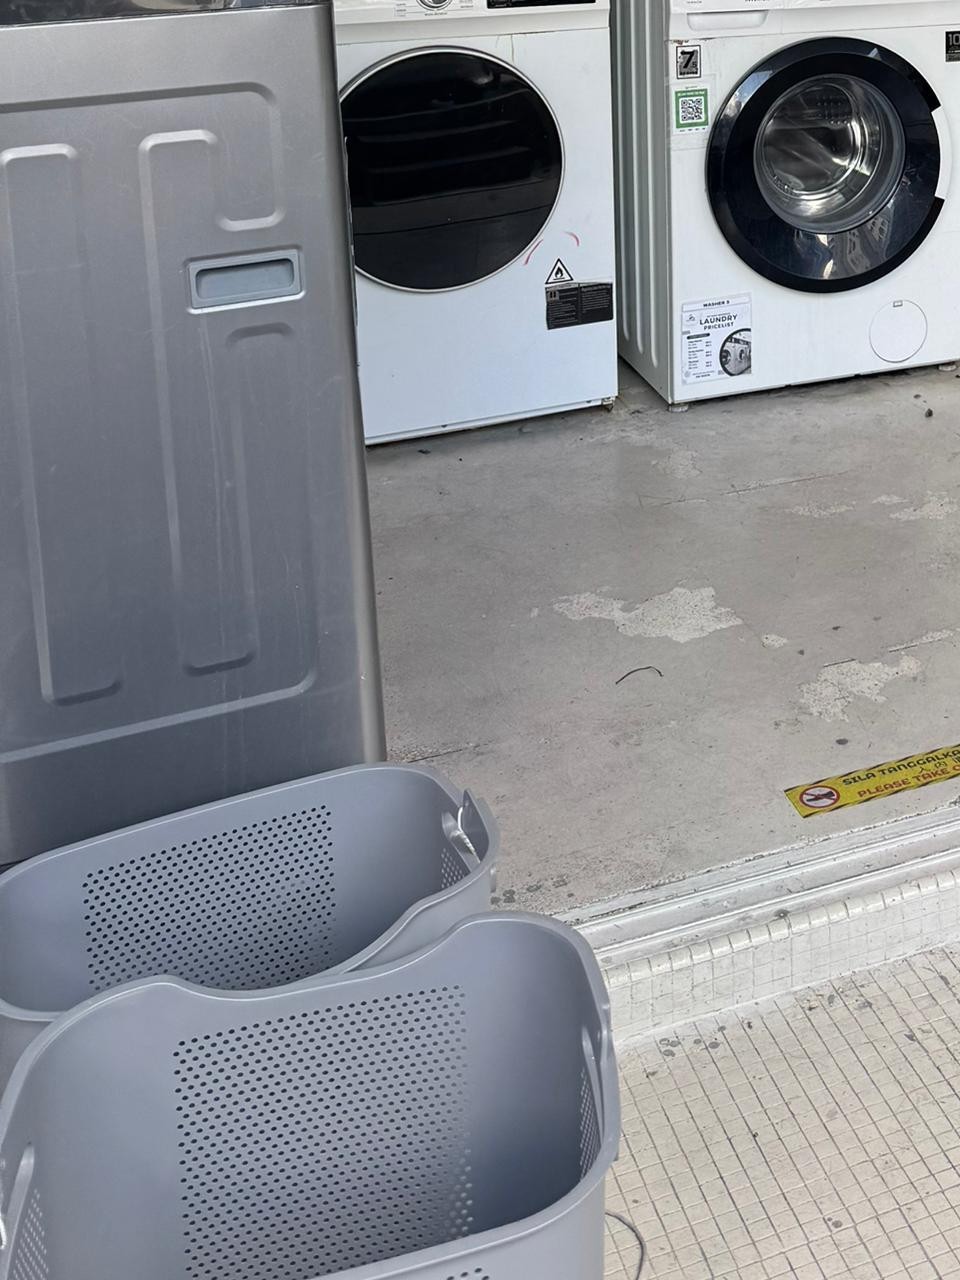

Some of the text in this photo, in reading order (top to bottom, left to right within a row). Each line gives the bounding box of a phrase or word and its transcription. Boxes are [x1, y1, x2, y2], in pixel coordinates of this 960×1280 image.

[948, 33, 960, 46] 10
[699, 314, 738, 325] LAUNDRY
[703, 322, 735, 330] PRICELIST
[842, 772, 877, 786] SILA
[858, 778, 911, 798] PLEASE
[912, 768, 950, 783] TAKE
